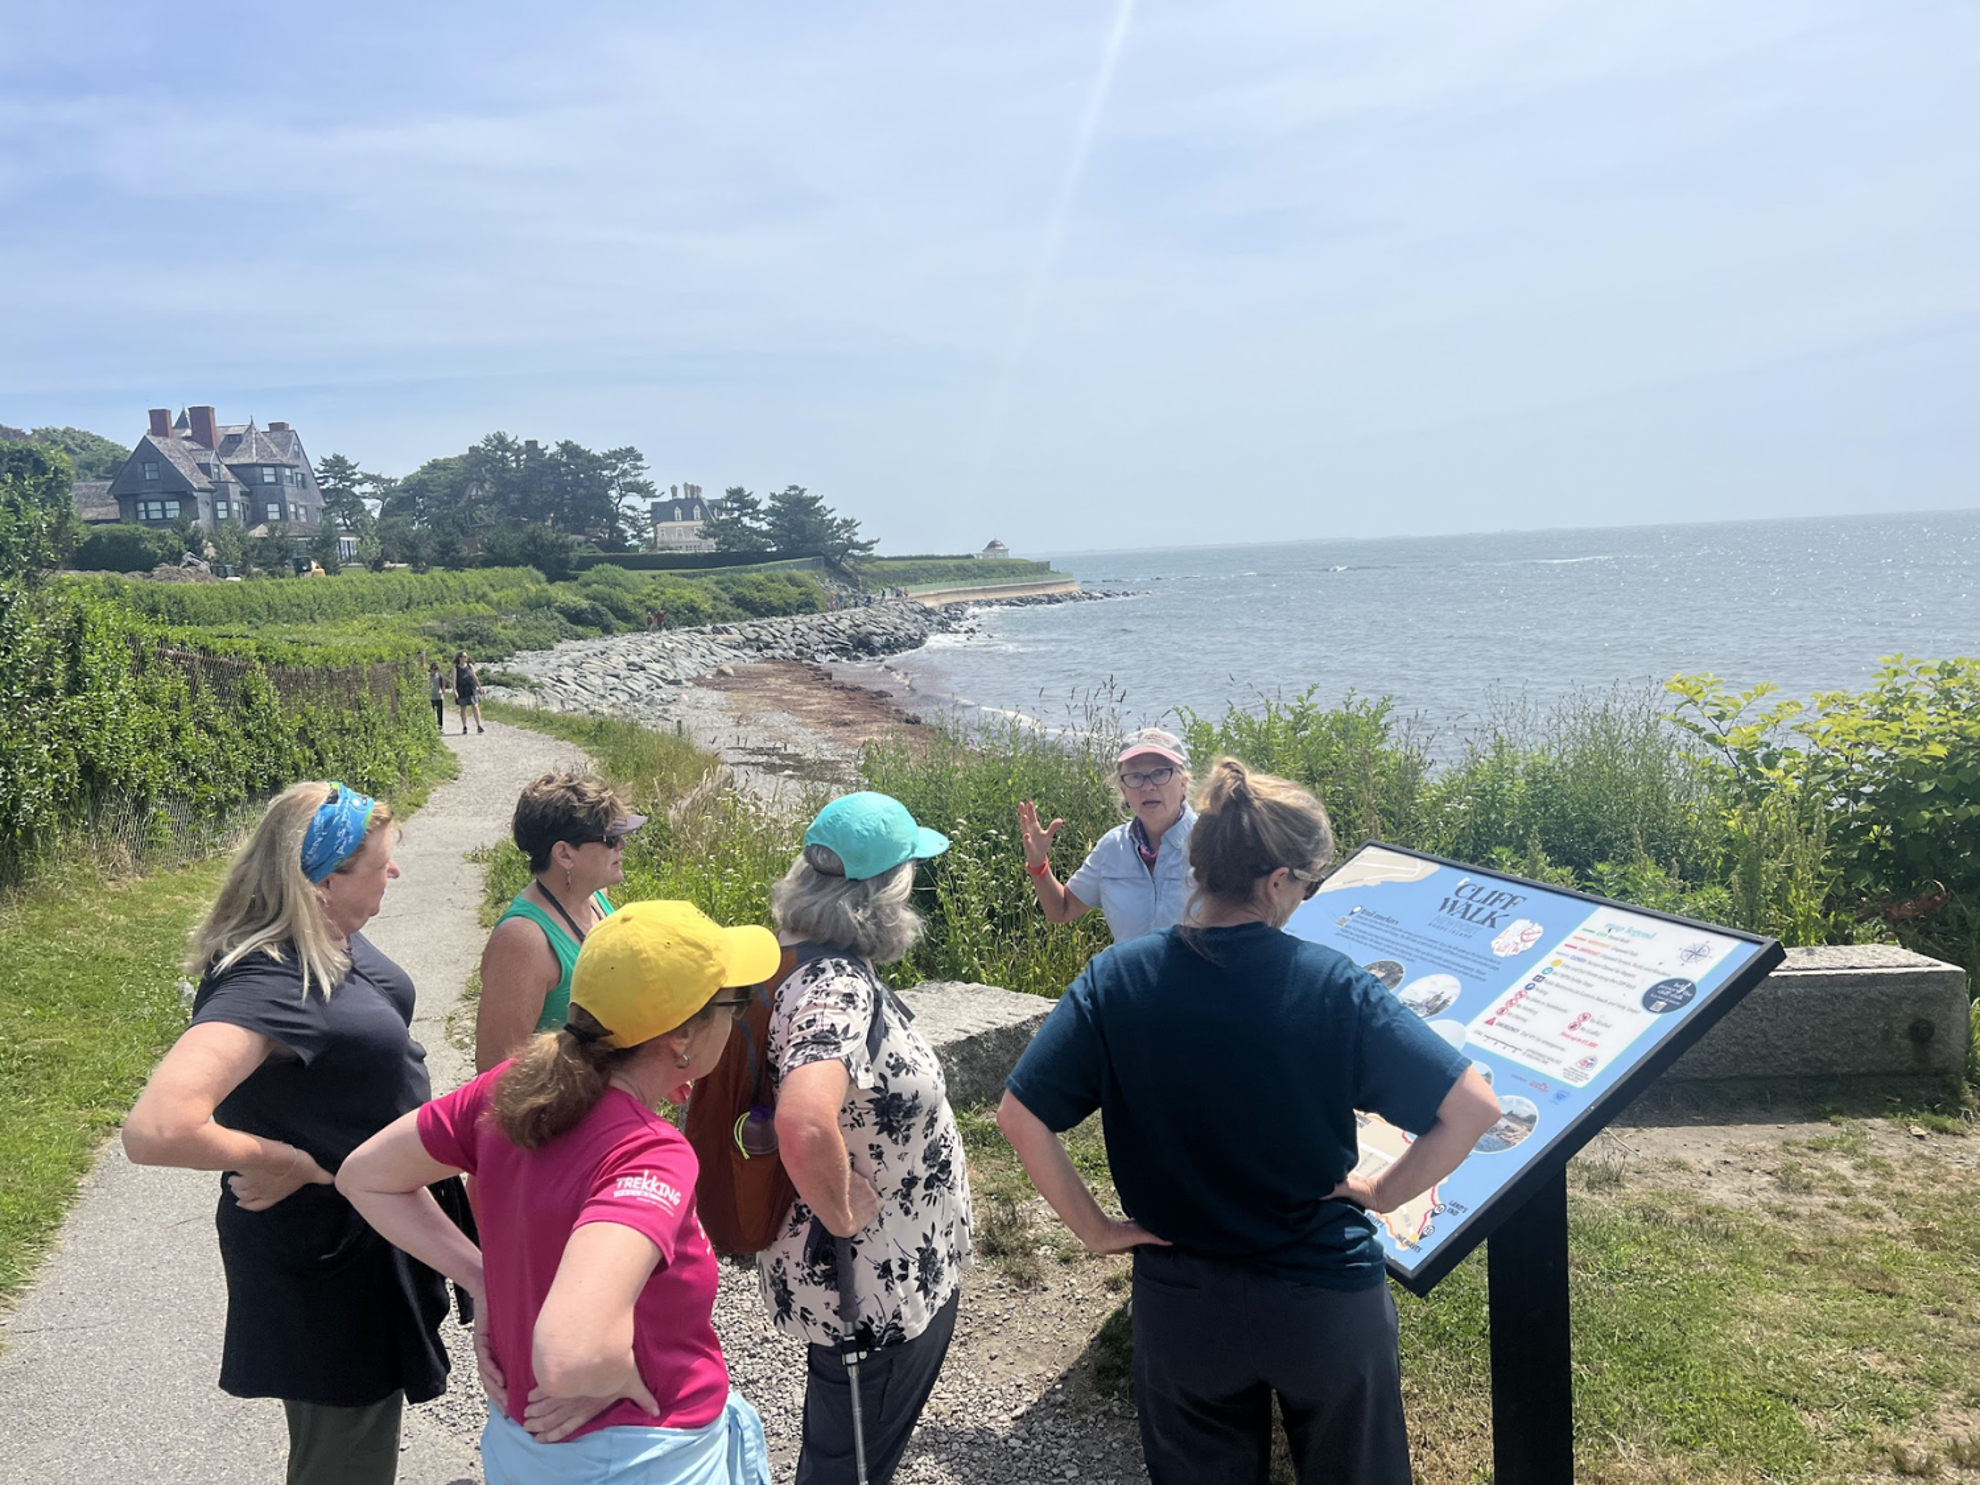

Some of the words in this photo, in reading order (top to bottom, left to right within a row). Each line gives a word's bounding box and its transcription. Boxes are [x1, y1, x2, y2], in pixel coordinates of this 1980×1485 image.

[1454, 883, 1528, 911] CLIFF
[1438, 897, 1510, 929] WALK
[1625, 926, 1658, 940] legend
[616, 1169, 681, 1206] TREKKING
[1446, 1207, 1460, 1217] END
[1448, 1199, 1468, 1213] LAND'S
